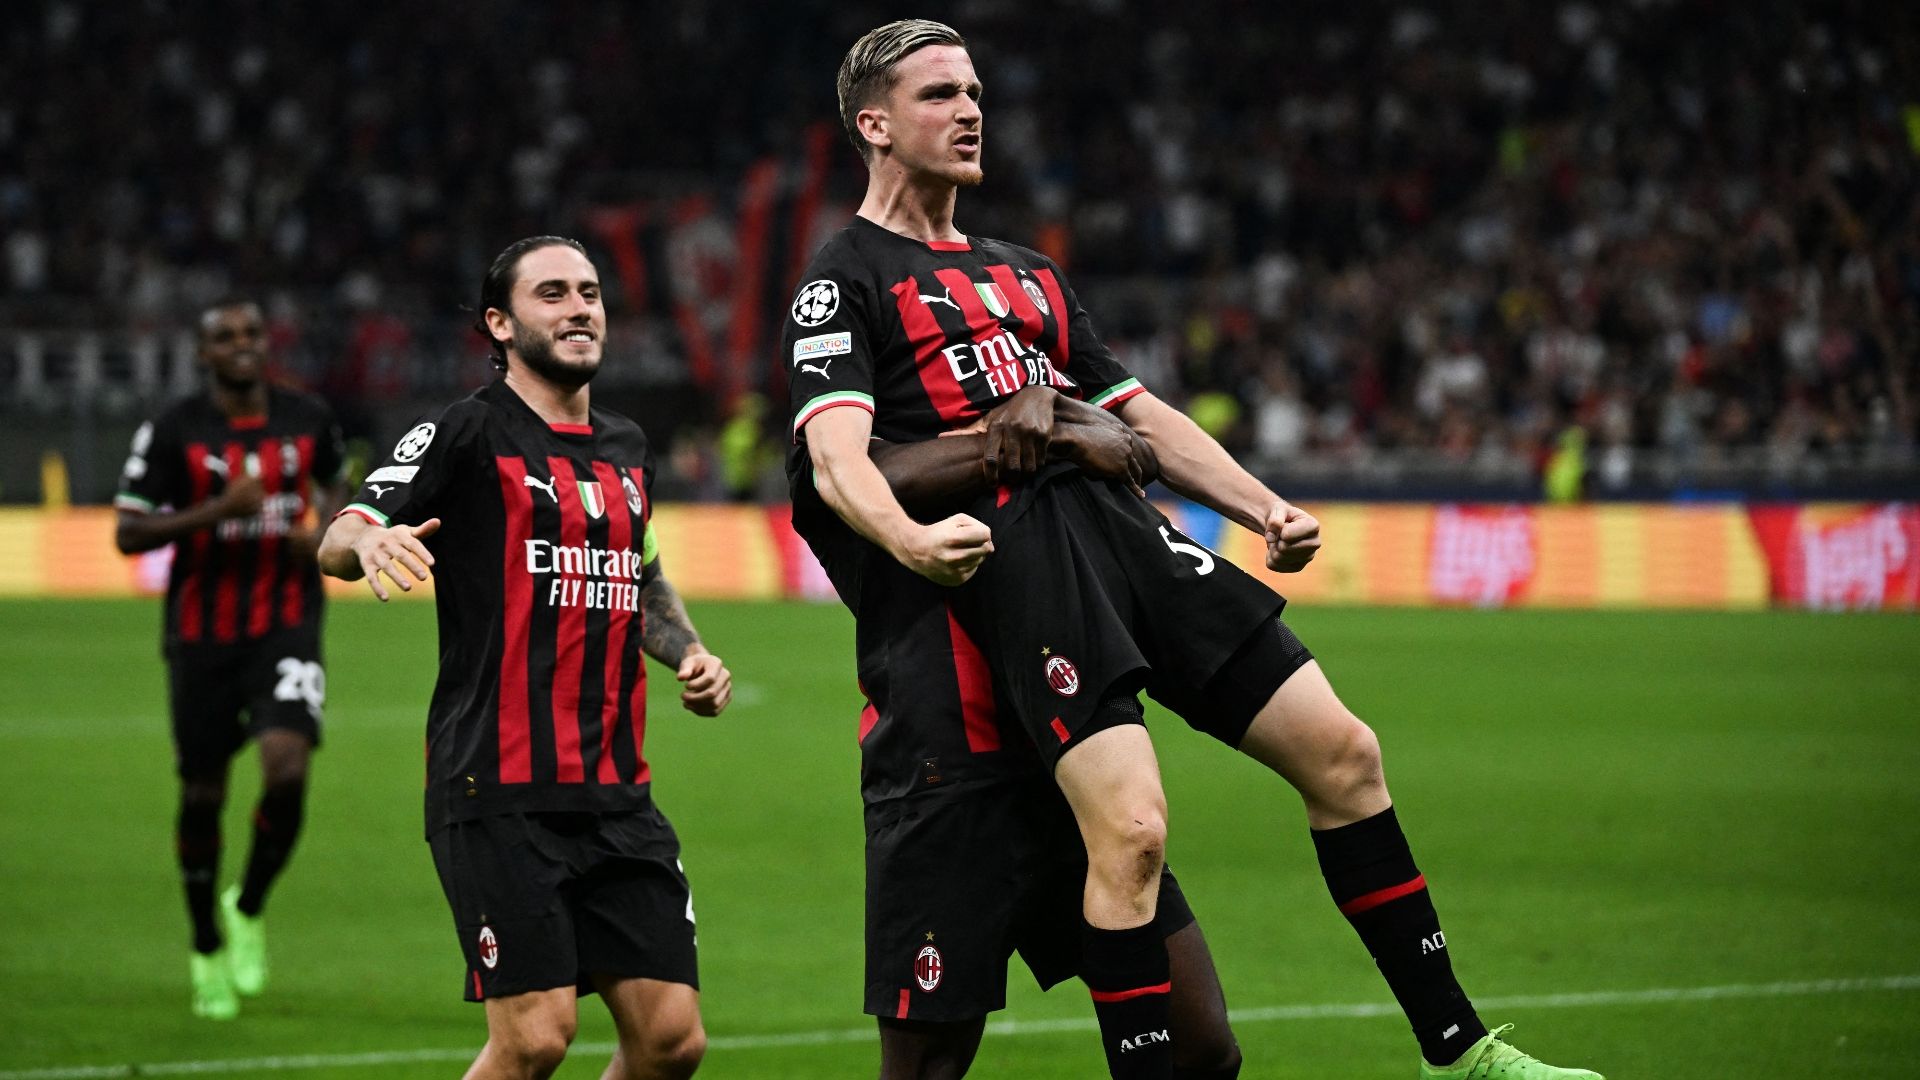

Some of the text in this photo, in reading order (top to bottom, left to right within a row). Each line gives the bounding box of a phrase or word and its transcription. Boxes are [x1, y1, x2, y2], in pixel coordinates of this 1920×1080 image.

[985, 362, 1020, 397] FLY
[524, 539, 642, 580] Emirate
[548, 578, 639, 612] FLY BETTER
[273, 657, 326, 716] 20
[1120, 1029, 1170, 1053] ACM
